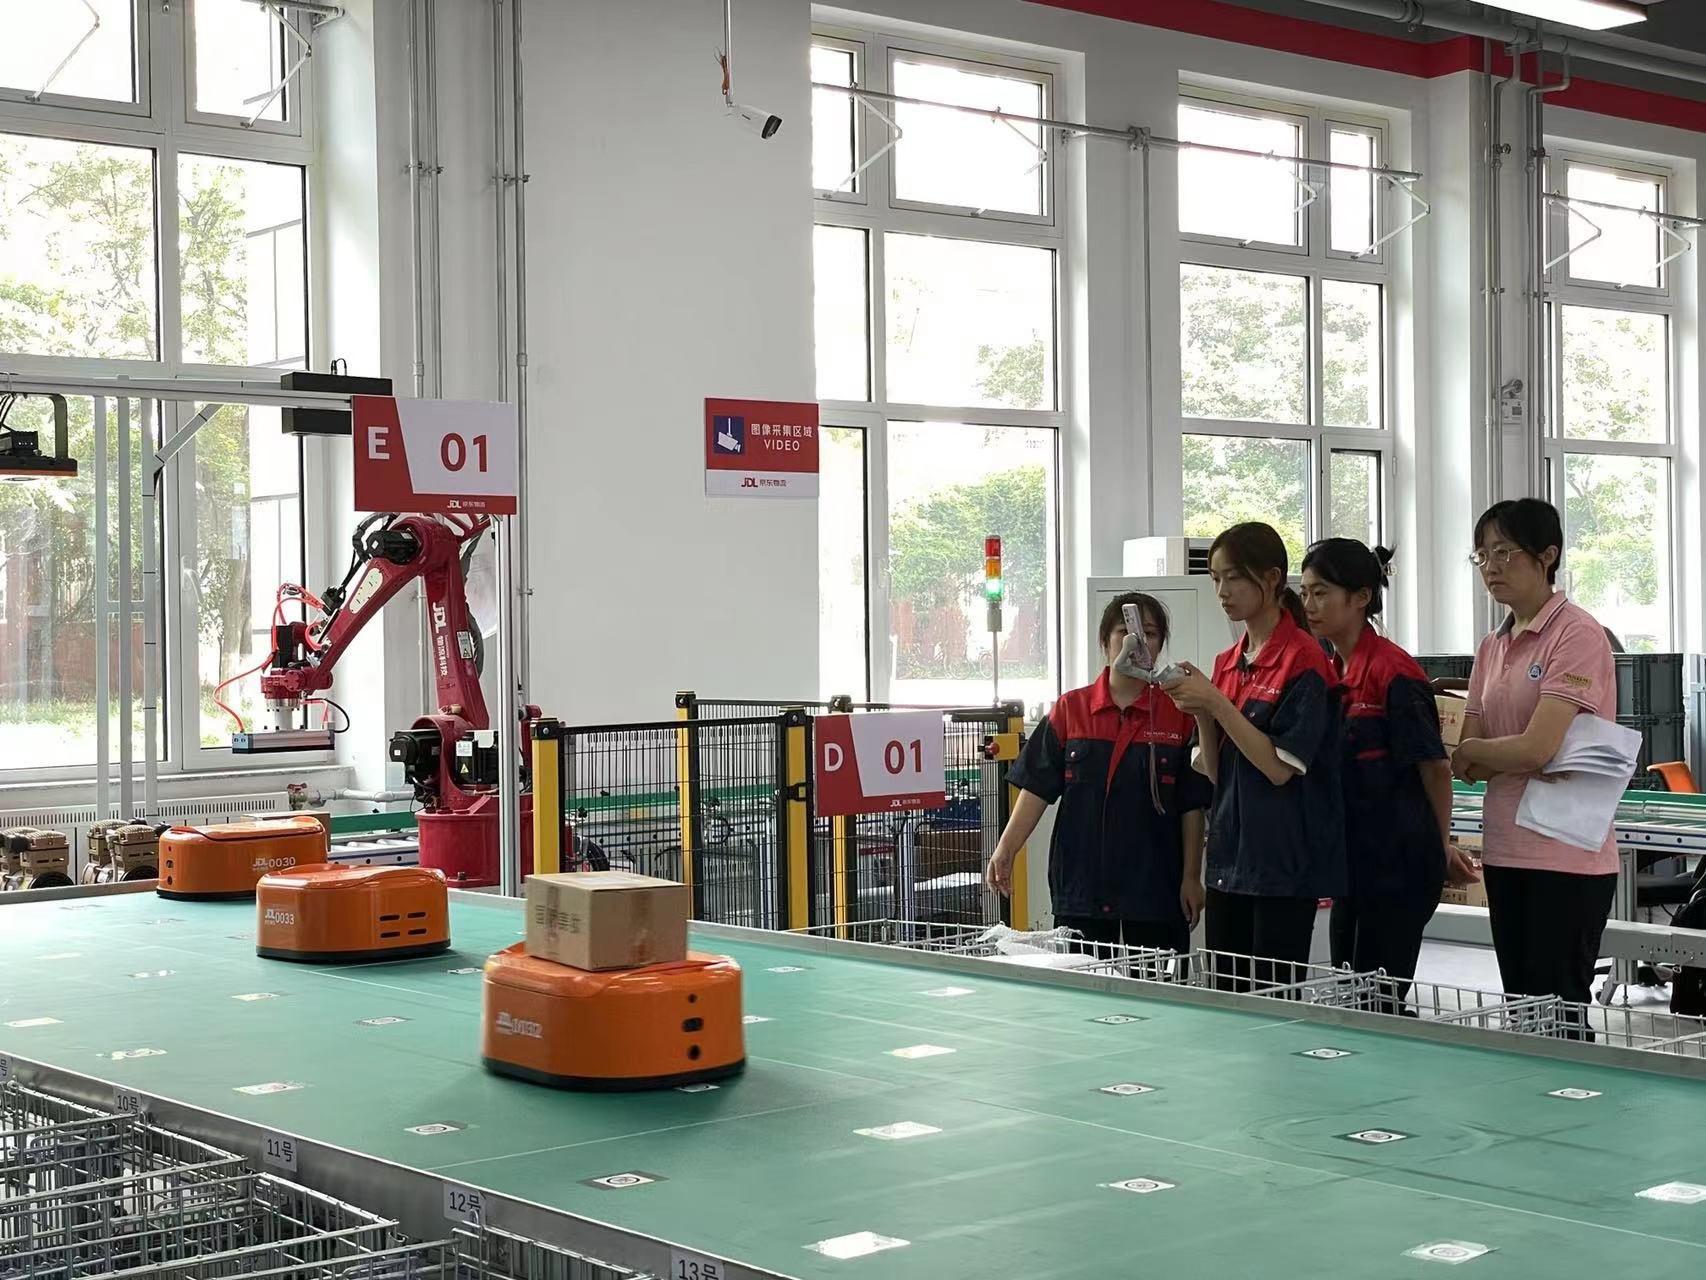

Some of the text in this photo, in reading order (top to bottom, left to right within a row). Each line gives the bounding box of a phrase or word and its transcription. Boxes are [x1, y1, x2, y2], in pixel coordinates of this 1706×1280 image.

[751, 423, 813, 438] 图像采集区域
[367, 426, 488, 472] E 01
[764, 439, 800, 451] VIDEO
[741, 478, 758, 488] JDL
[447, 500, 462, 508] JDL
[432, 602, 447, 634] JDL
[824, 739, 922, 775] D 01
[268, 856, 296, 868] 0030
[275, 912, 295, 925] 0033
[117, 1094, 139, 1116] 10号
[267, 1138, 293, 1162] 11号
[450, 1191, 481, 1218] 12号
